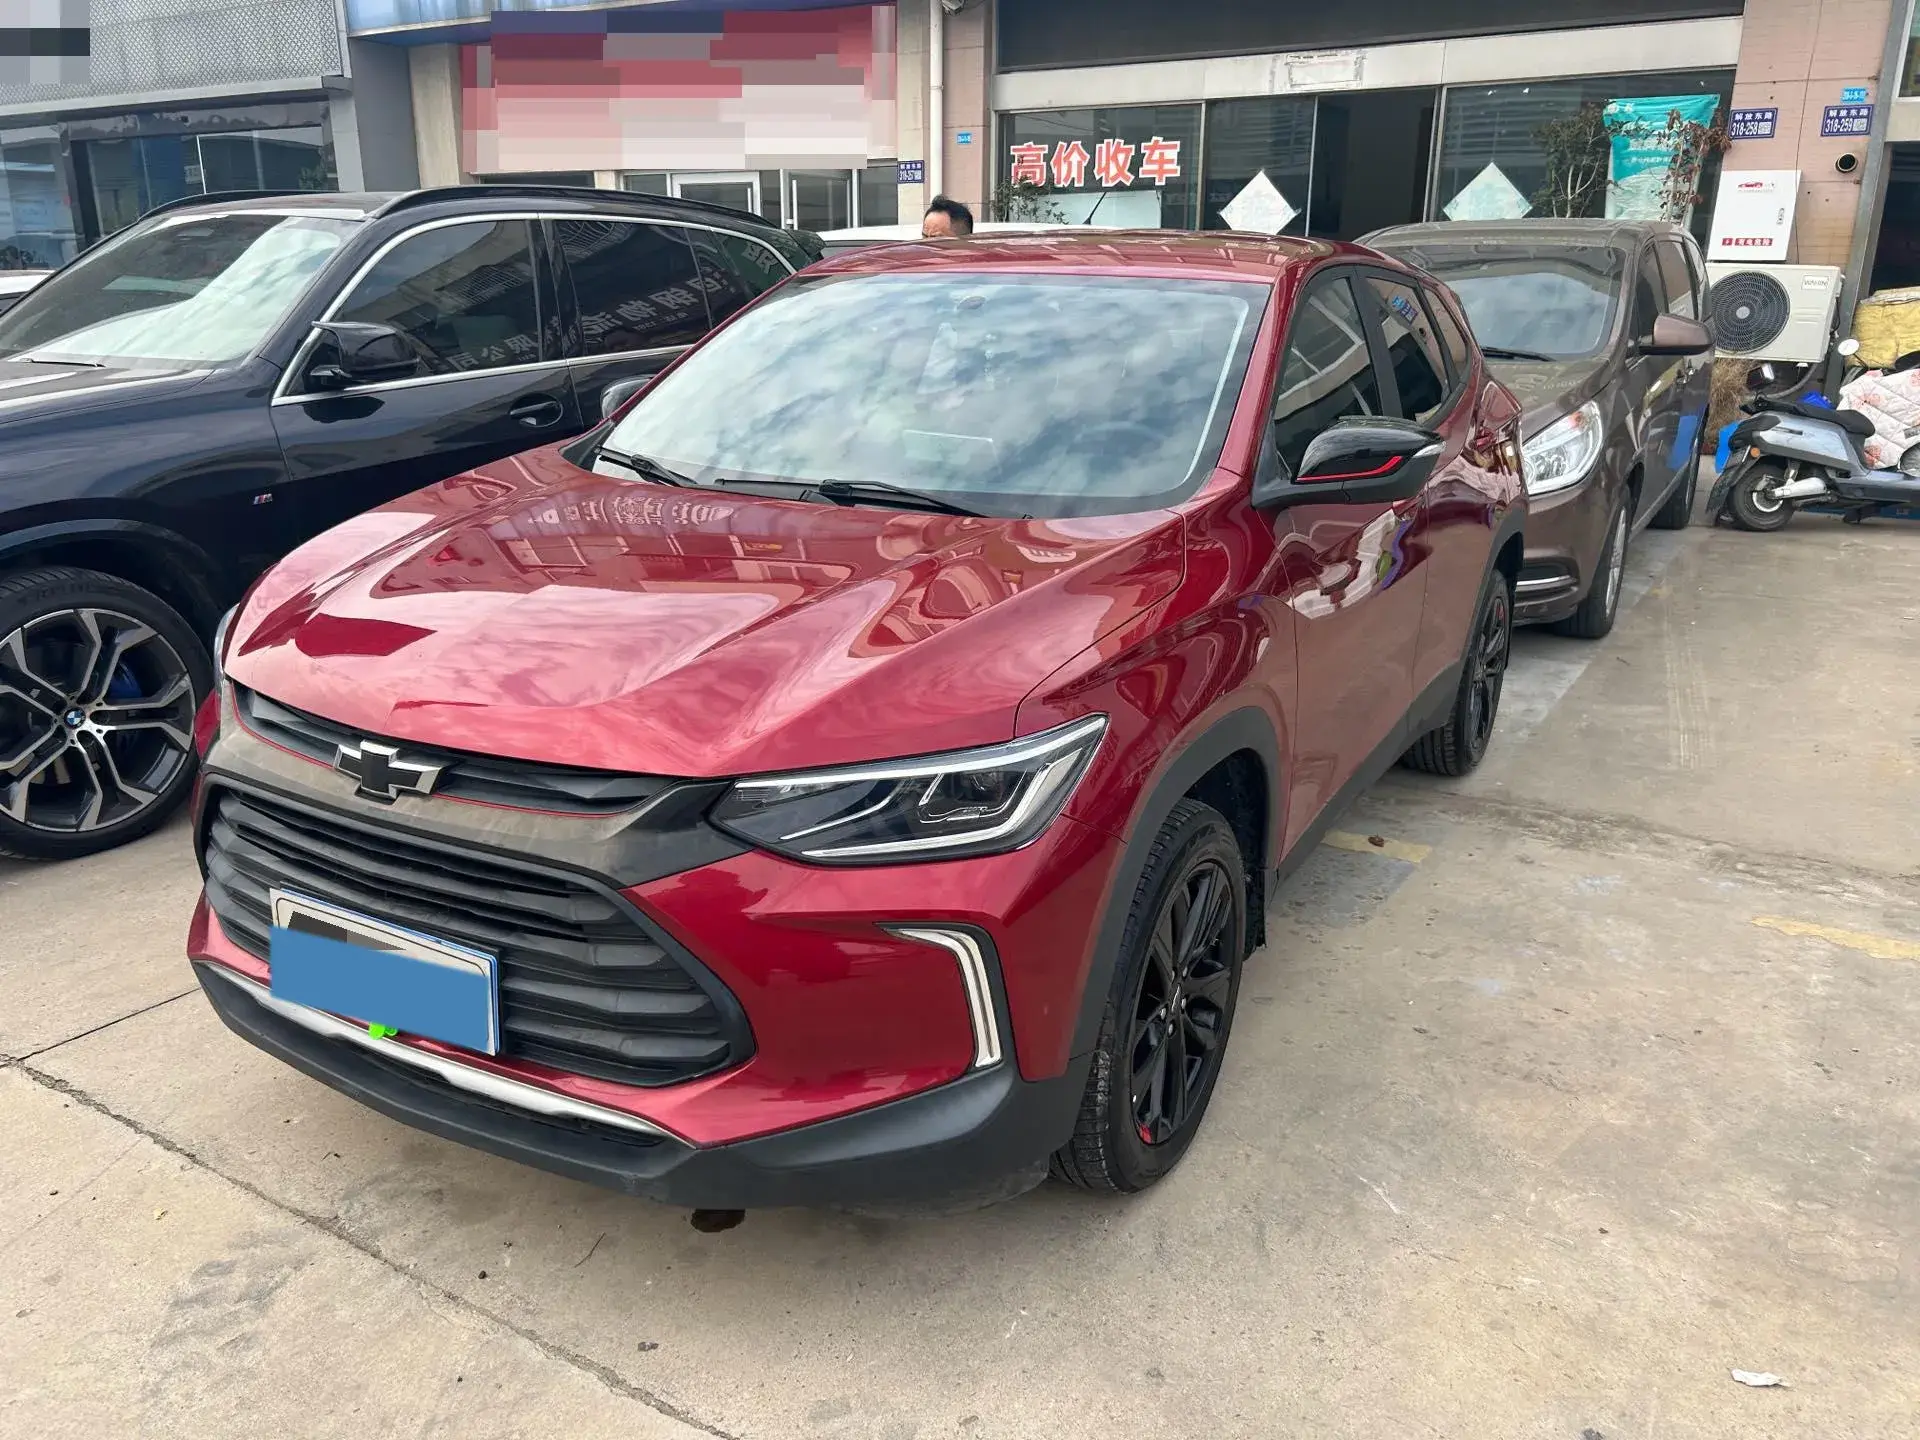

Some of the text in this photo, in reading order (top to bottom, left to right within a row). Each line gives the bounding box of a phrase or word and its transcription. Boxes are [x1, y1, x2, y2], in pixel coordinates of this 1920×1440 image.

[1731, 121, 1758, 137] 318-258
[1825, 118, 1853, 133] 318-259
[1009, 135, 1182, 188] 高价收车
